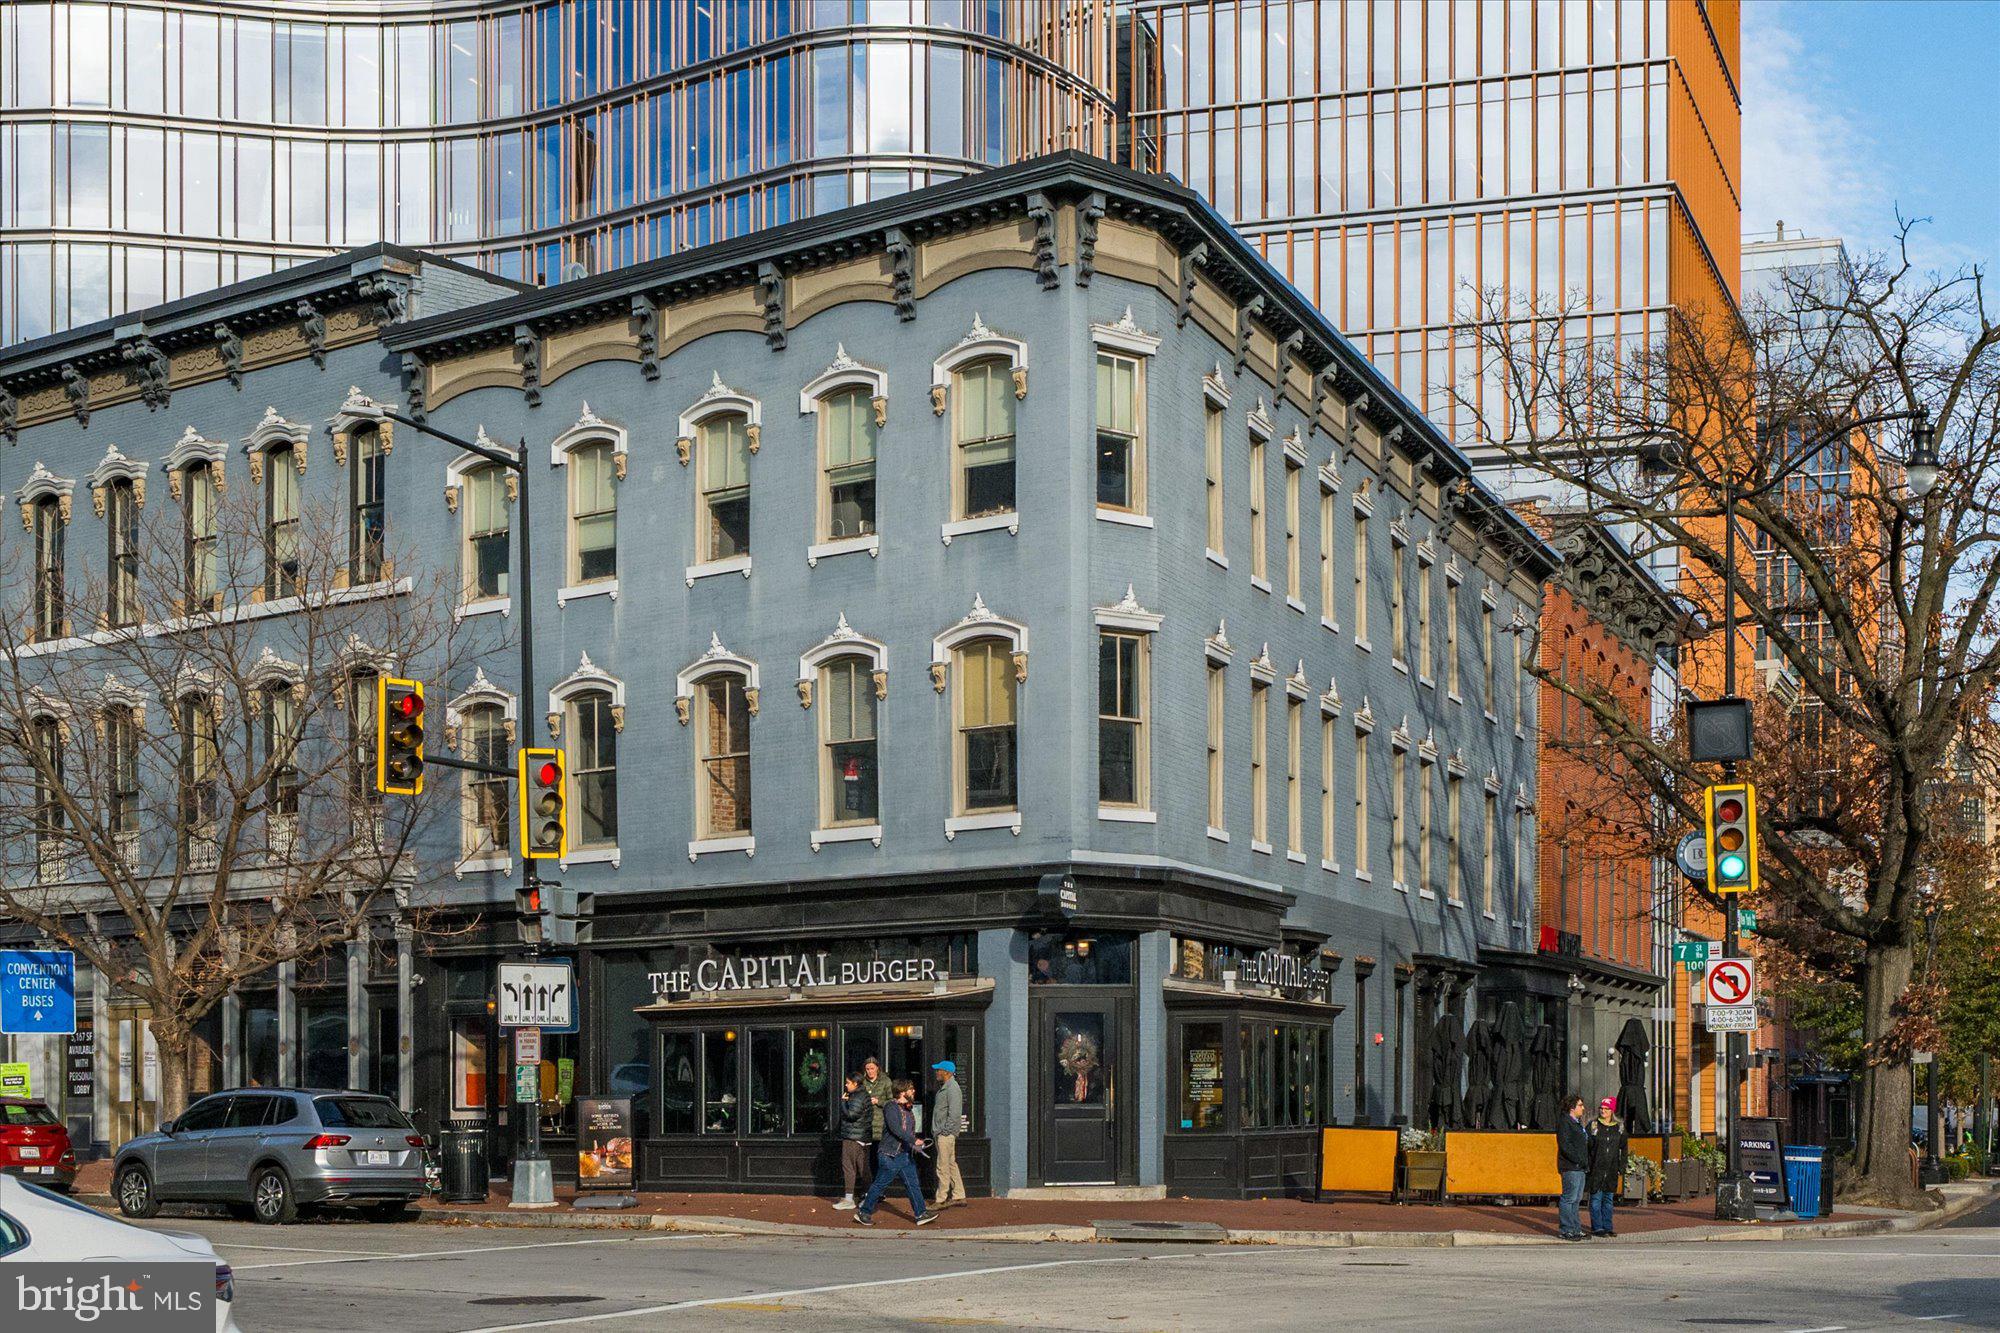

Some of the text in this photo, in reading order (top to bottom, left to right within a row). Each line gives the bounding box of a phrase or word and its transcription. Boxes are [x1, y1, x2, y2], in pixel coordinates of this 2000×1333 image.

[1678, 944, 1702, 959] 7 St
[7, 962, 67, 976] CONVENTION
[647, 953, 936, 994] THE CAPITAL BURGER
[1241, 959, 1257, 982] THE
[1258, 951, 1303, 988] CAPITAL
[19, 977, 56, 990] CENTER
[22, 994, 54, 1007] BUSES
[504, 1014, 518, 1022] ONLY
[73, 1085, 91, 1094] LOBBY
[1740, 1140, 1771, 1149] PARKING
